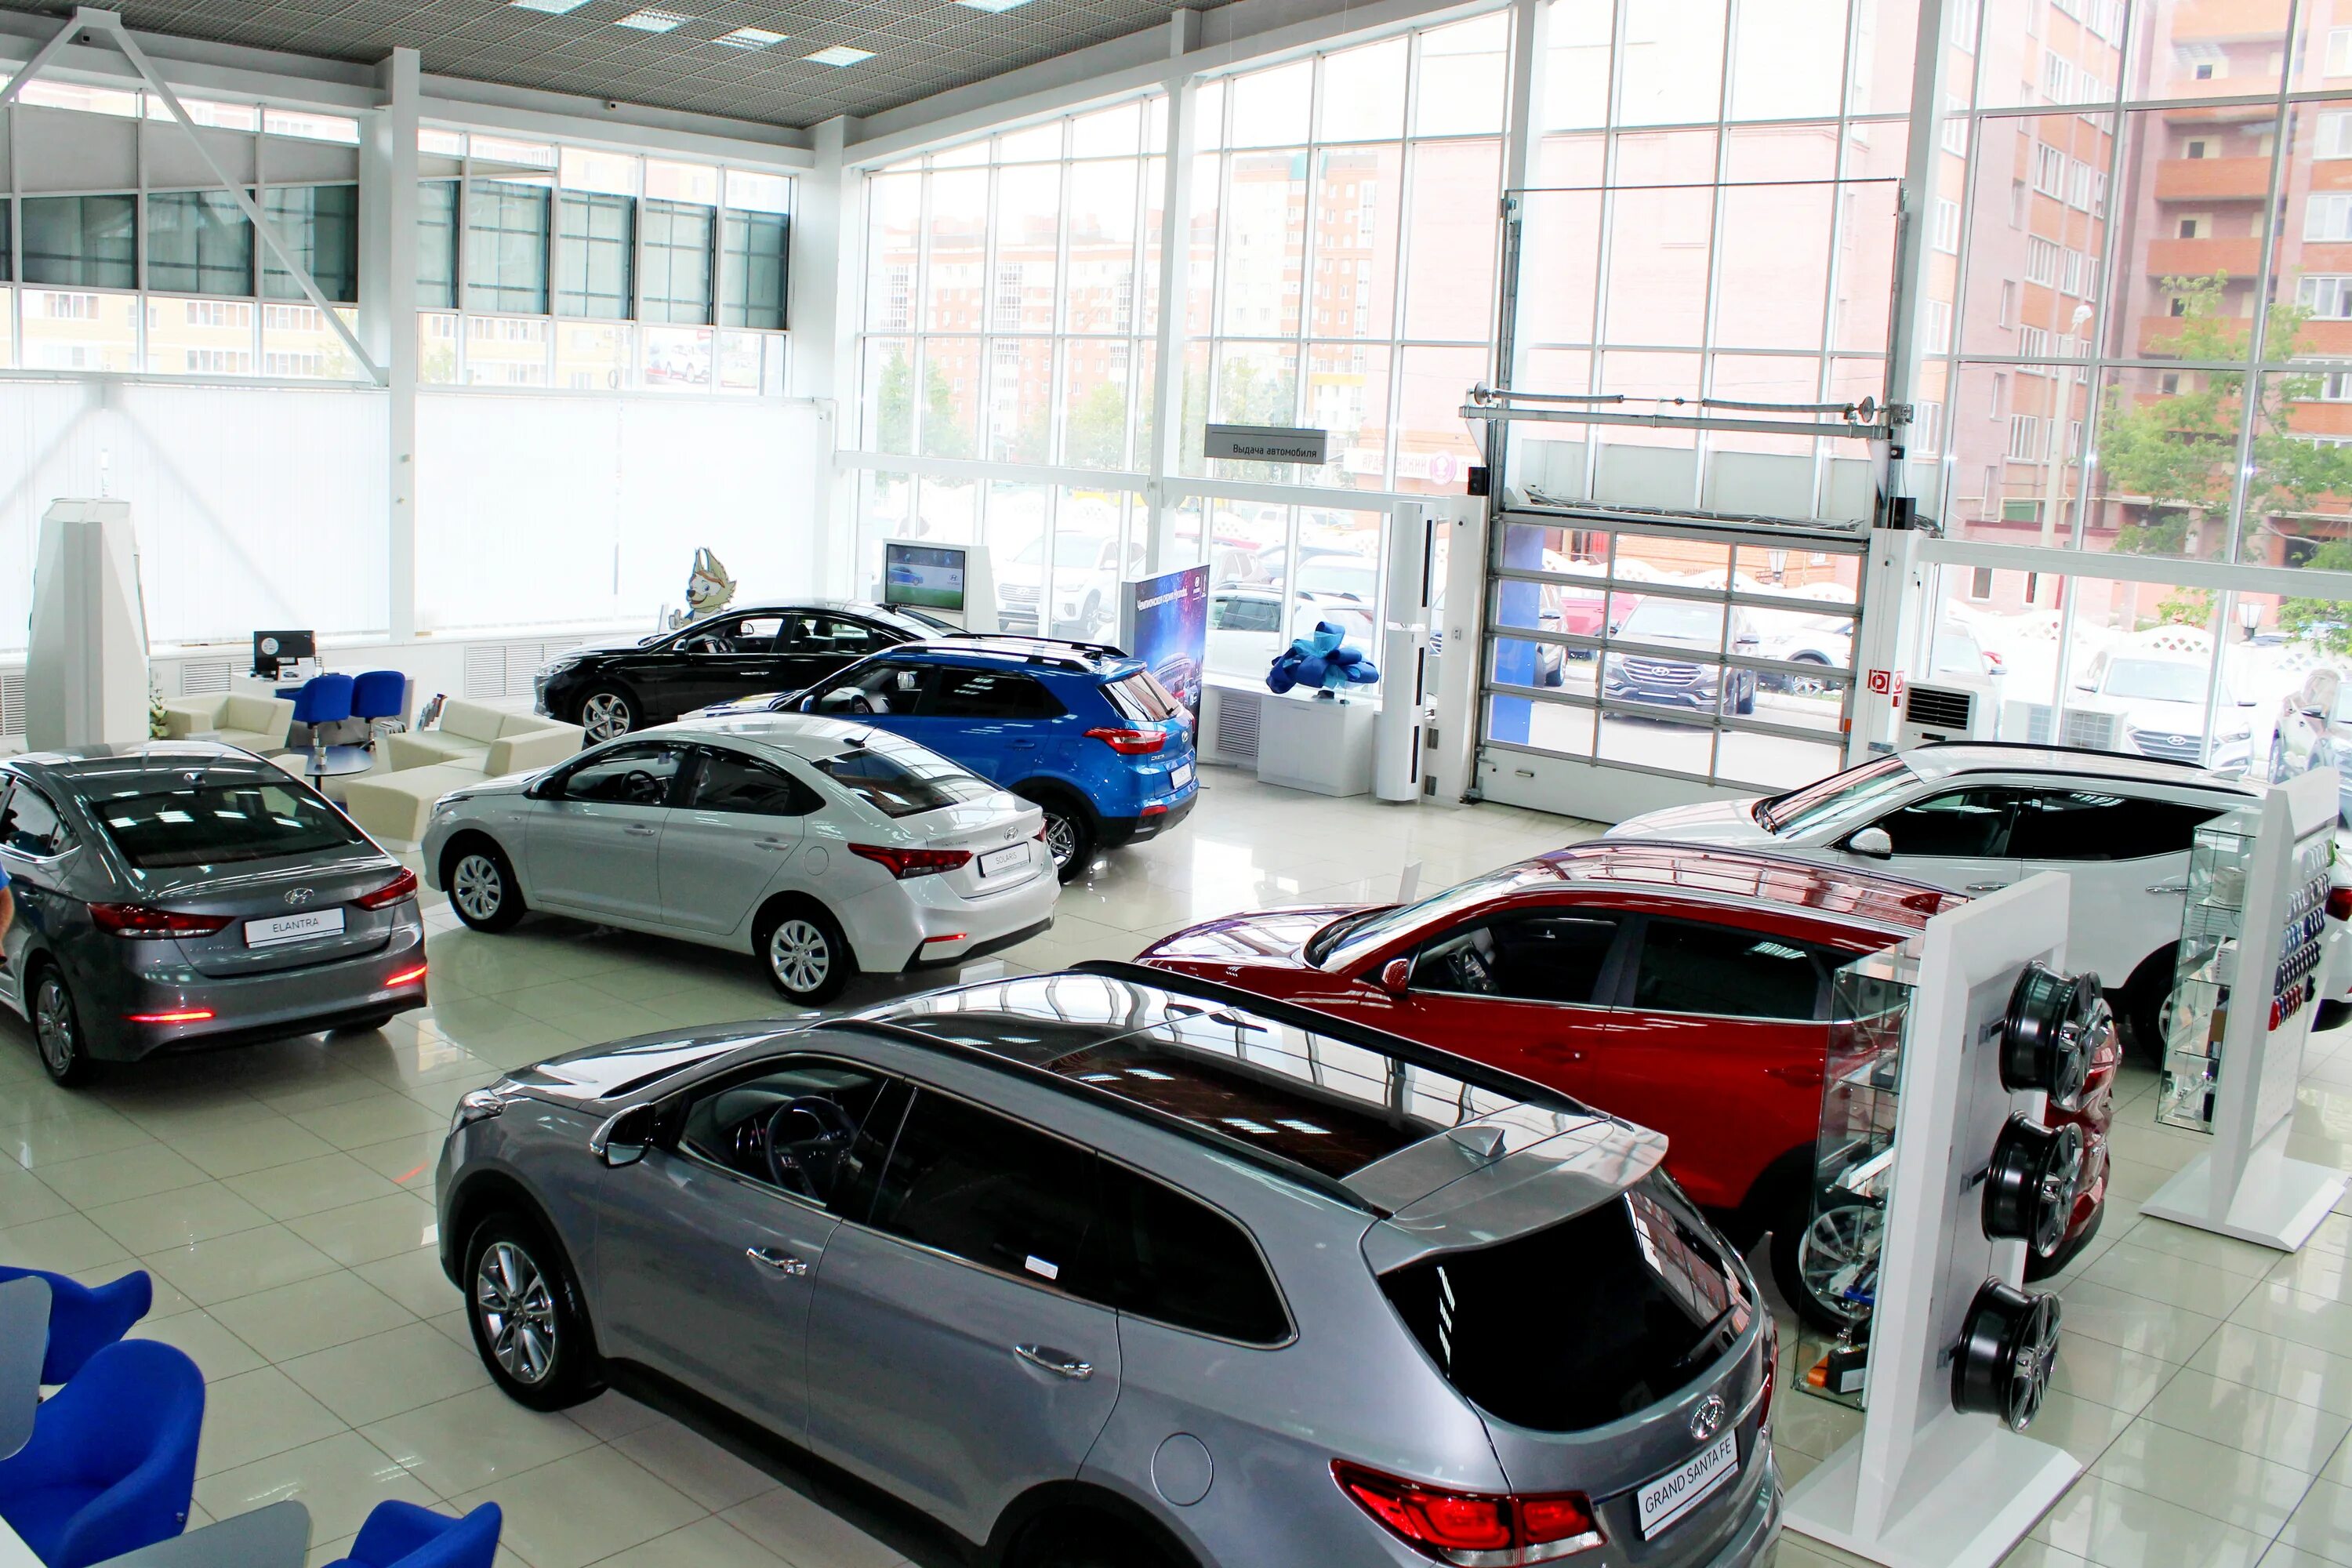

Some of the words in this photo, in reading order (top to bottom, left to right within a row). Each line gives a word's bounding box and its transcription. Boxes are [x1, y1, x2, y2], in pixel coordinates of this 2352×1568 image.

[1232, 444, 1264, 456] Выдача
[1266, 446, 1317, 459] автомобиля
[996, 851, 1018, 865] SOLARIS
[273, 917, 320, 933] ELANTRA
[1645, 1474, 1686, 1514] GRAND
[1686, 1449, 1719, 1484] SANTA
[1720, 1437, 1732, 1458] FE
